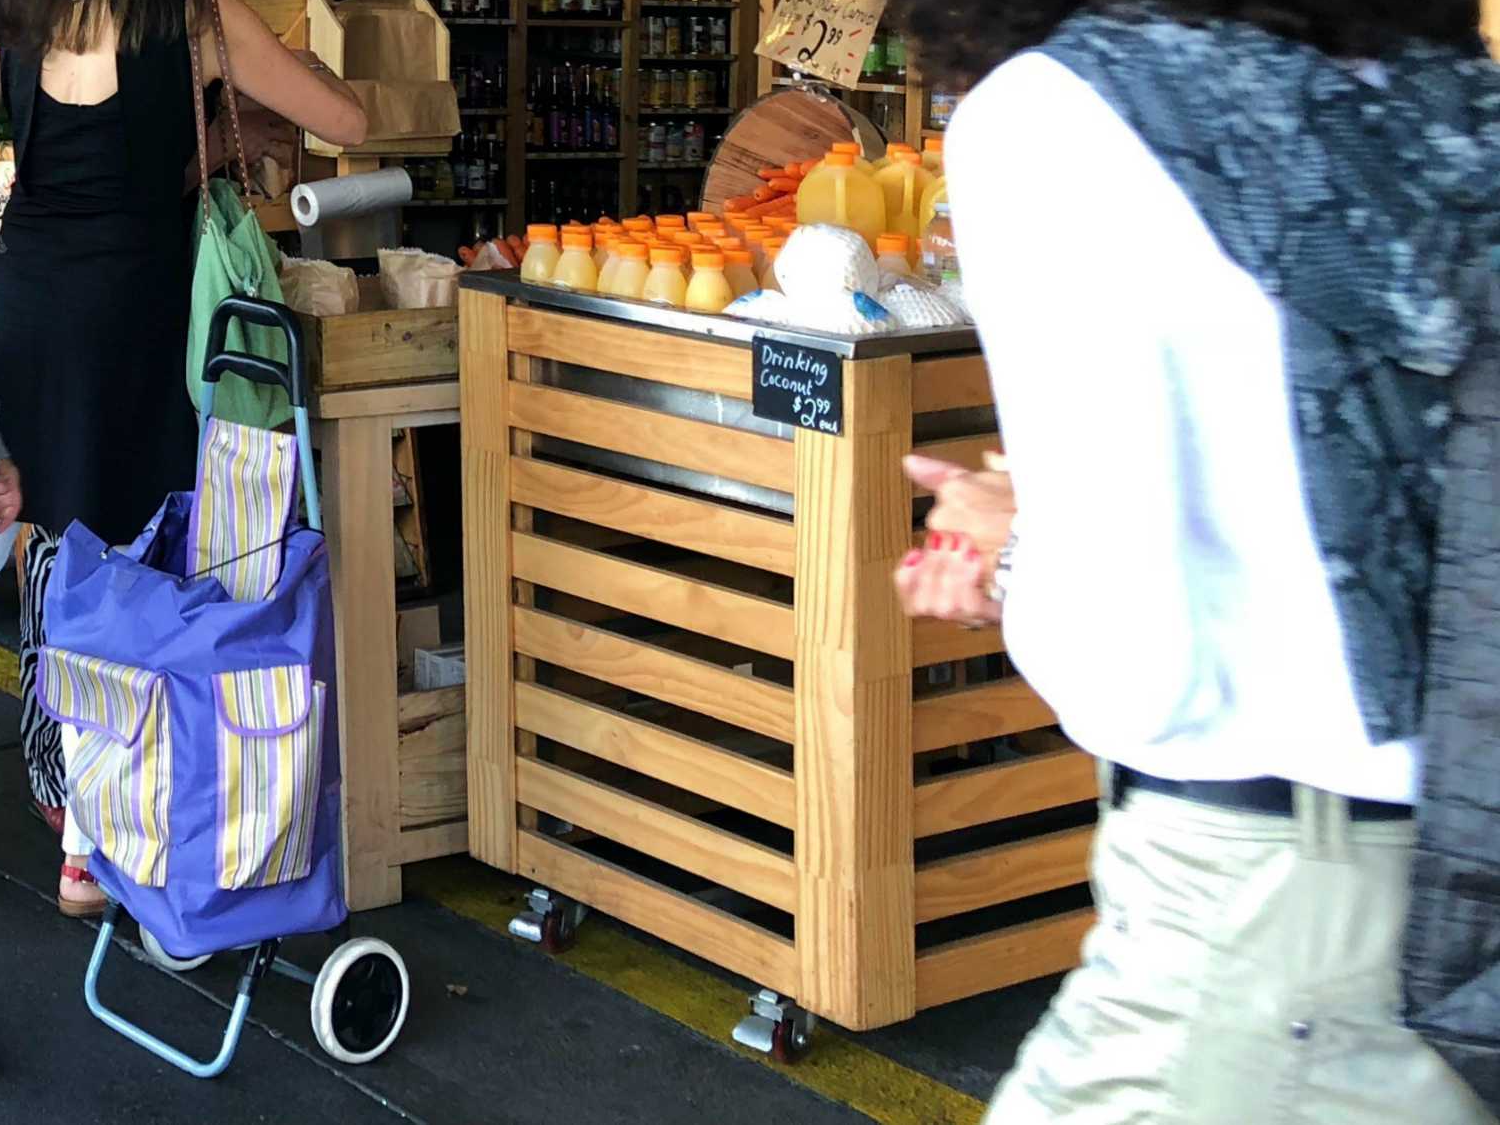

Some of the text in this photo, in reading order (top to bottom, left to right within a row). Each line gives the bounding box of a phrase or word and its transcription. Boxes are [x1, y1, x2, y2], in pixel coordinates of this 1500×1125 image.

[761, 344, 828, 386] Drinking
[760, 369, 813, 395] Coconut
[819, 419, 838, 433] each
